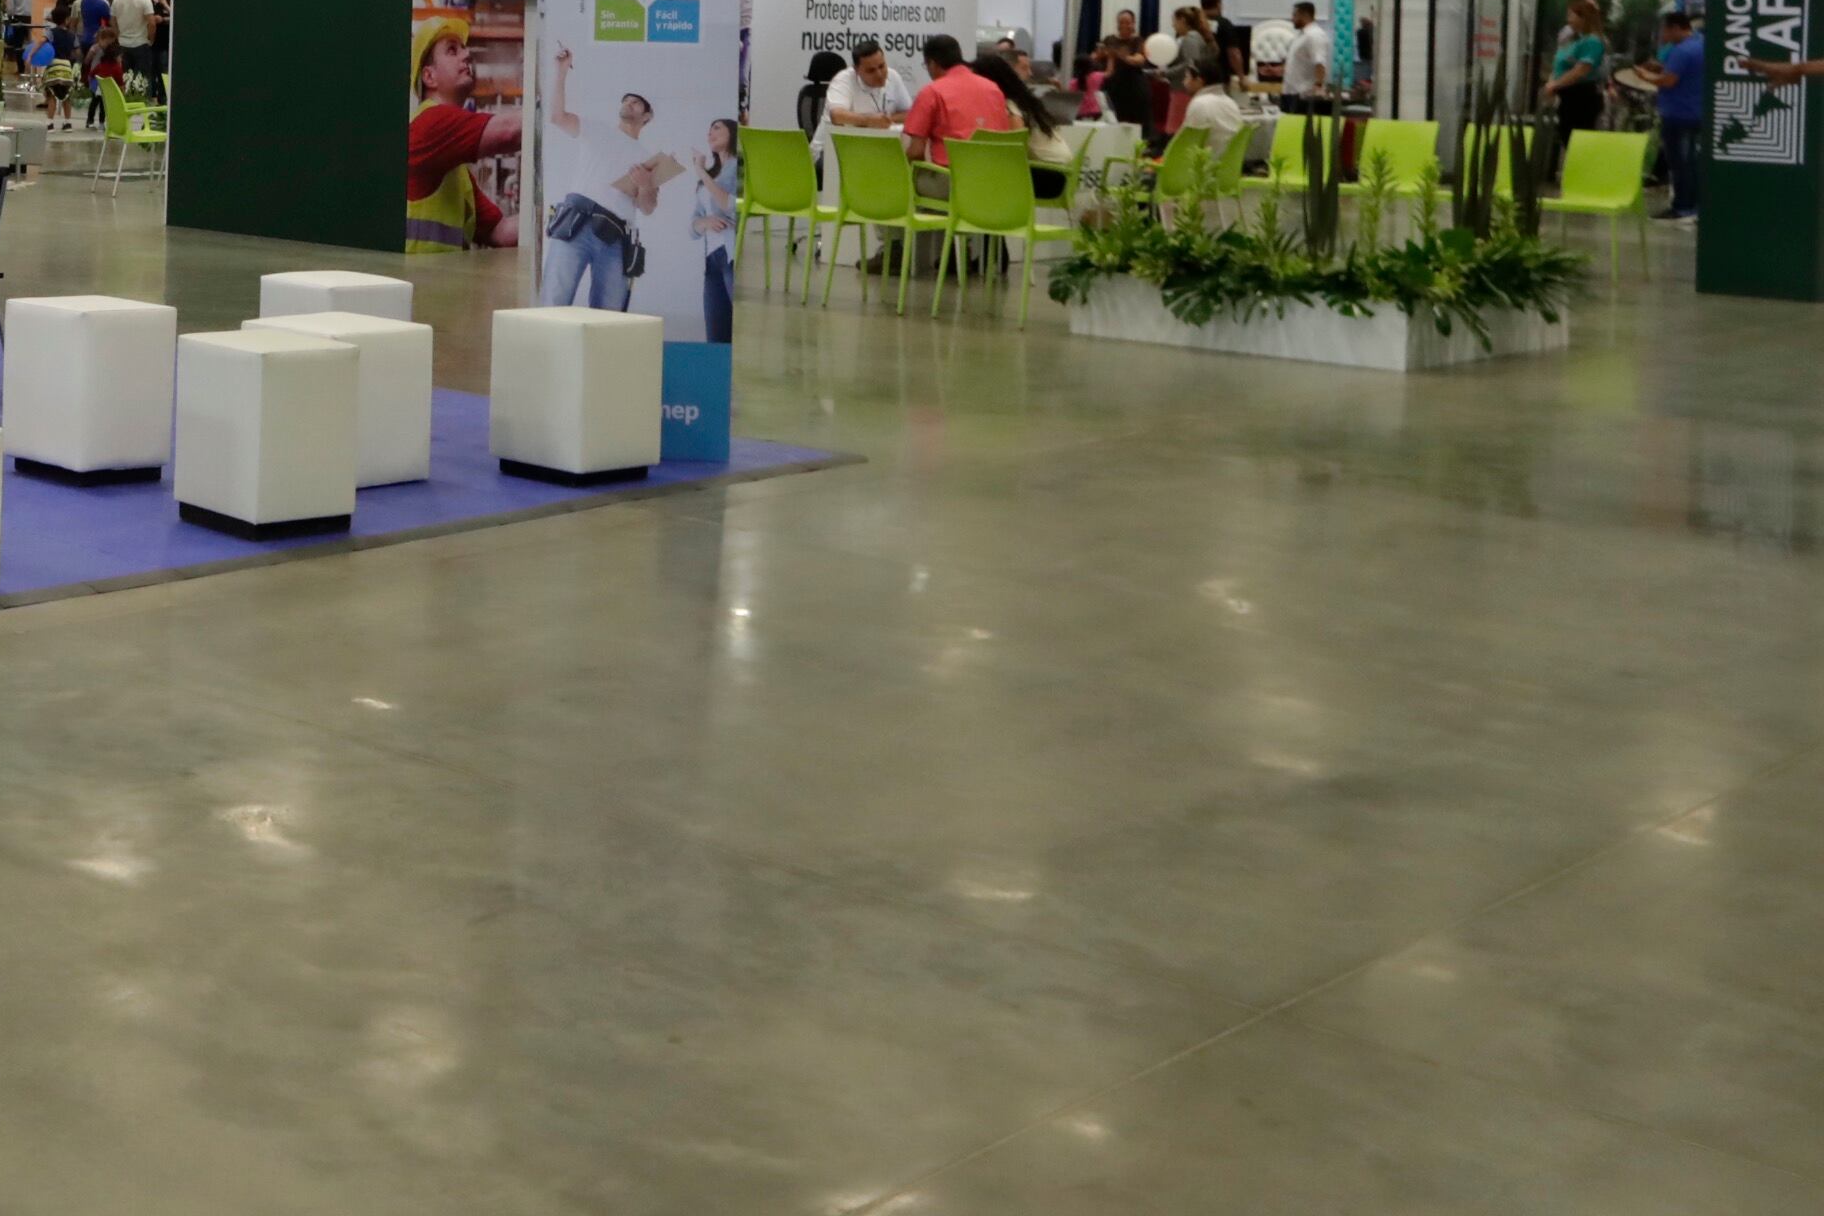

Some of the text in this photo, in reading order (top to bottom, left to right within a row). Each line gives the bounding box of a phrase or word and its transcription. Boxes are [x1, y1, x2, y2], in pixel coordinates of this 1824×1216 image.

[600, 10, 615, 19] Sin
[655, 10, 678, 20] Fácil
[859, 0, 877, 22] tus
[881, 0, 921, 23] bienes
[924, 7, 946, 23] con
[656, 19, 694, 31] y rápido
